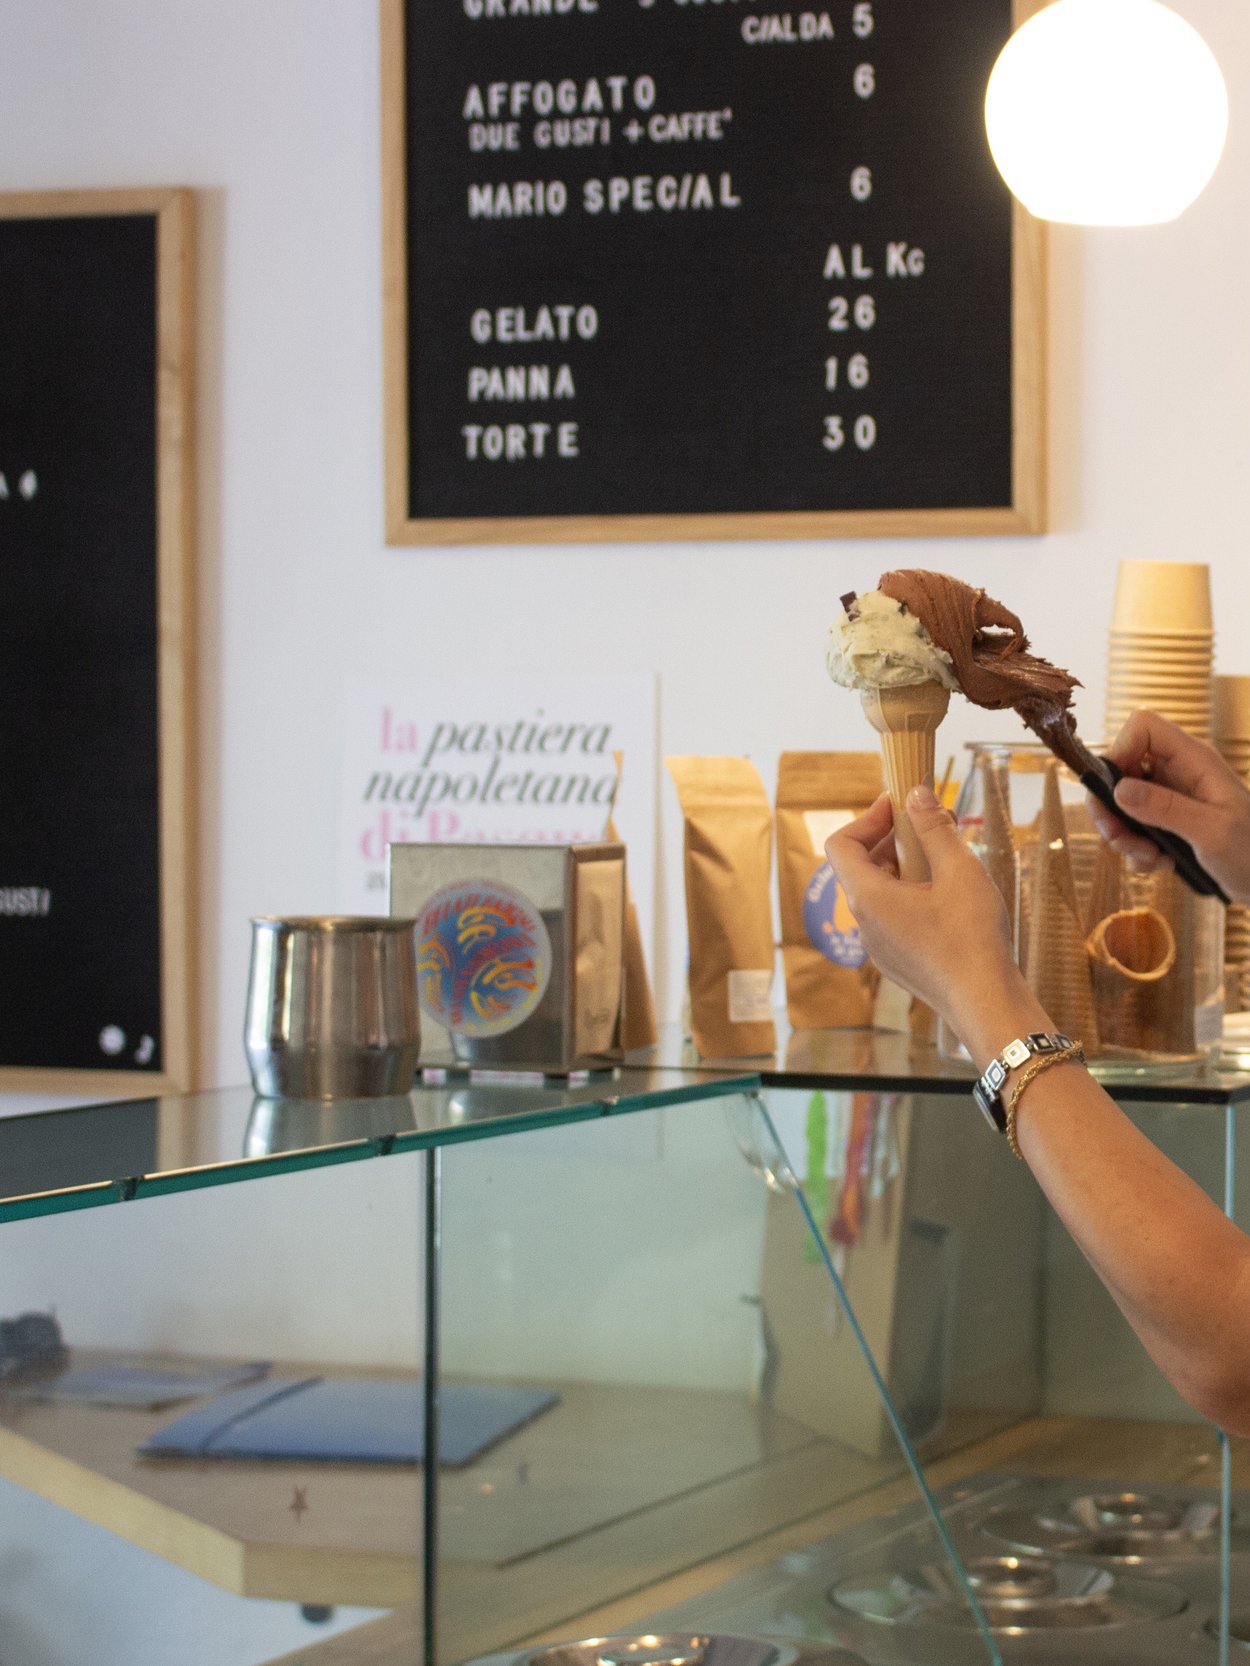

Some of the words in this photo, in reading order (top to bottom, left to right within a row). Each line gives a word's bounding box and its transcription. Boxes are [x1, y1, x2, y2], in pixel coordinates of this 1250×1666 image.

[853, 3, 875, 38] 5
[463, 76, 656, 119] AFFOGATO
[854, 64, 876, 99] 6
[469, 123, 520, 152] DUE
[533, 118, 611, 148] GUSTI
[469, 182, 568, 218] MARIO
[851, 167, 872, 202] 6
[824, 245, 873, 279] AL
[472, 306, 599, 344] GELATO
[829, 296, 877, 332] 26
[469, 366, 575, 402] PANNA
[826, 354, 870, 391] 16
[462, 423, 580, 460] TORTE
[823, 416, 878, 452] 30
[379, 705, 418, 752] la
[420, 708, 613, 768] pastiera
[362, 753, 617, 819] napoletana
